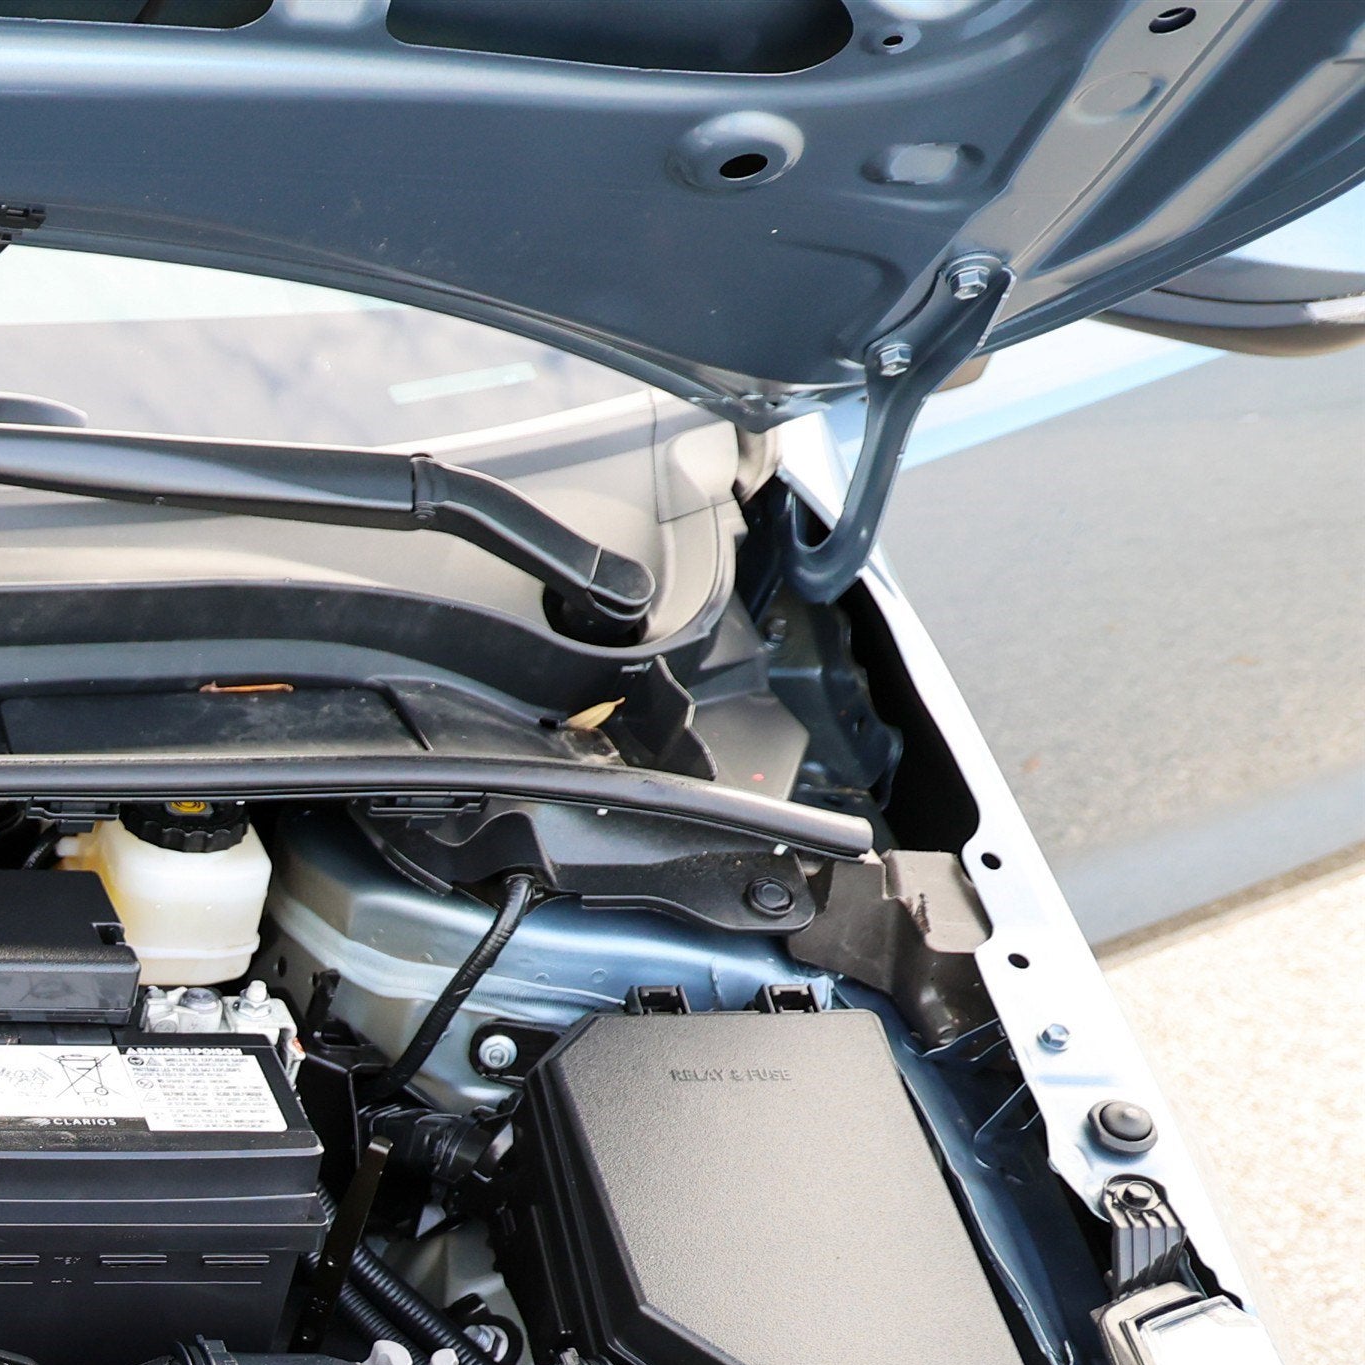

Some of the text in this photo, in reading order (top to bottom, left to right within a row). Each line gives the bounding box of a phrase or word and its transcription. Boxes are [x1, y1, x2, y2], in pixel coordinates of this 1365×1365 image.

[669, 1068, 724, 1081] RELAY
[748, 1068, 792, 1081] FUSE
[52, 1116, 118, 1128] CLARIOS
